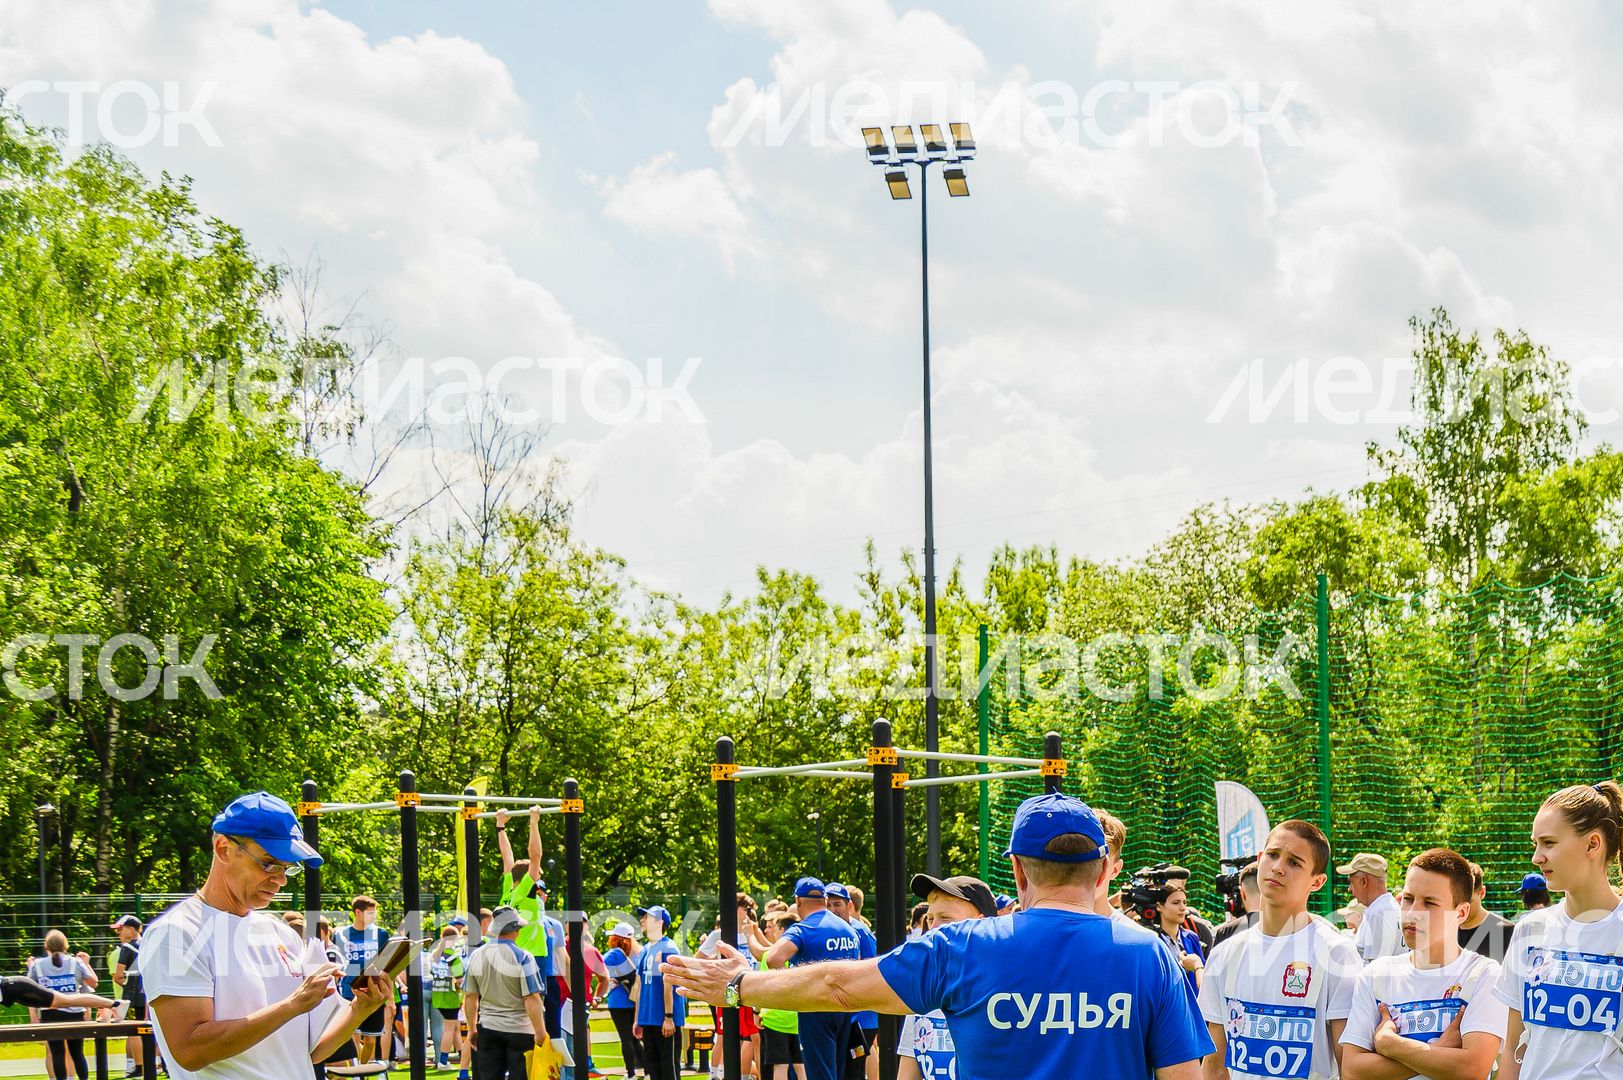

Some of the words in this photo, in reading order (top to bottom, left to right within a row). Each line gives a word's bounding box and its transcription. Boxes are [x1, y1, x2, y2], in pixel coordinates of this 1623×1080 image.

[826, 937, 859, 951] СУДЬЯ
[987, 992, 1133, 1035] СУДЬЯ
[1527, 988, 1616, 1030] 12-04
[1229, 1039, 1307, 1075] 12-07
